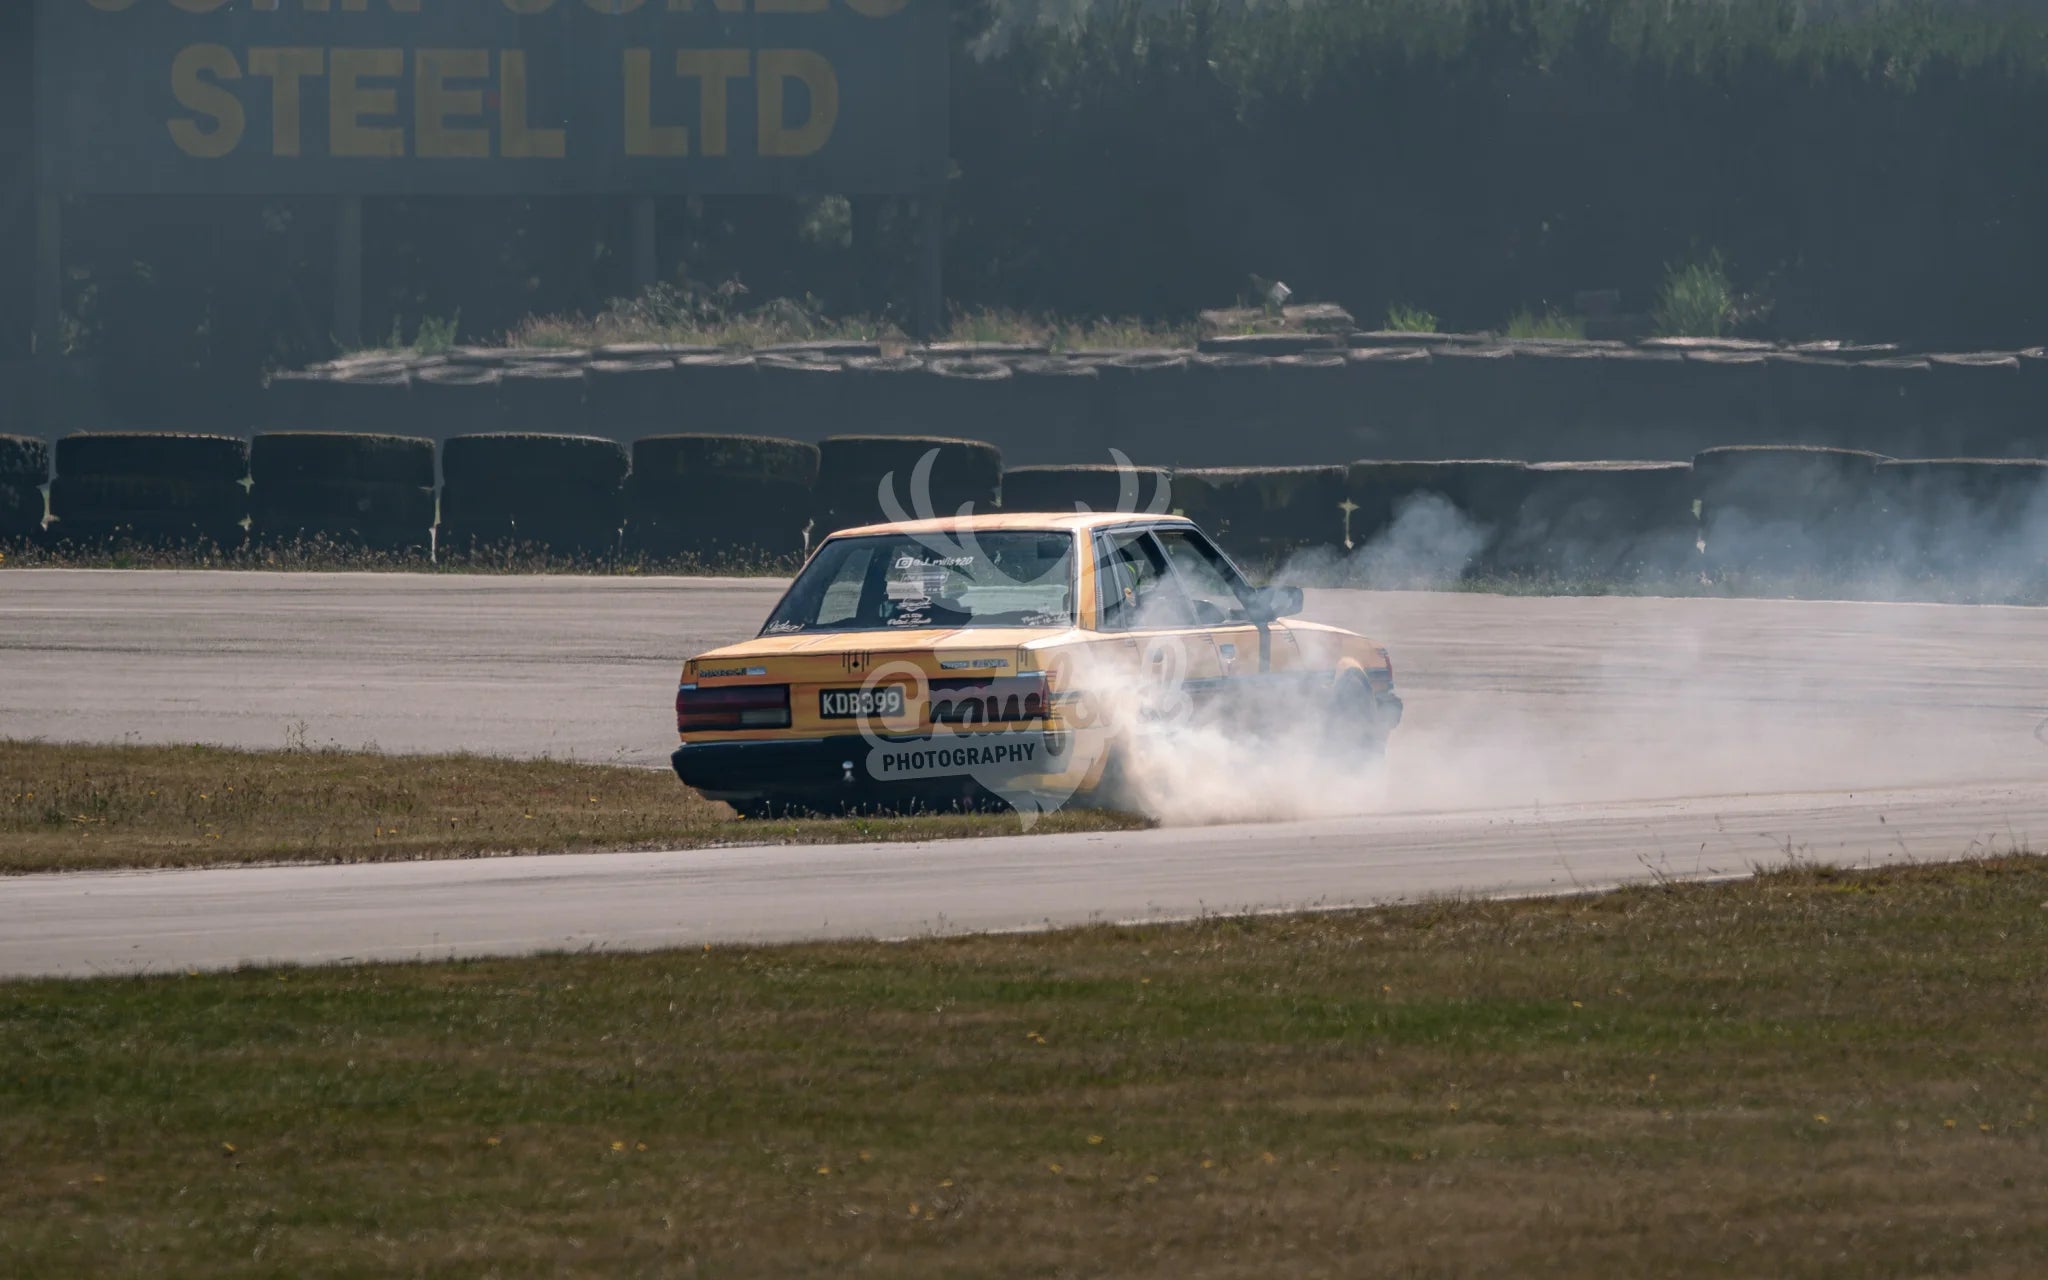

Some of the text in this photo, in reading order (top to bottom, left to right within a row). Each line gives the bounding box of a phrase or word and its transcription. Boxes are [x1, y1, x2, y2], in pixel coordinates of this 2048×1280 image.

[166, 44, 840, 159] STEEL LTD
[822, 691, 901, 715] KDB399
